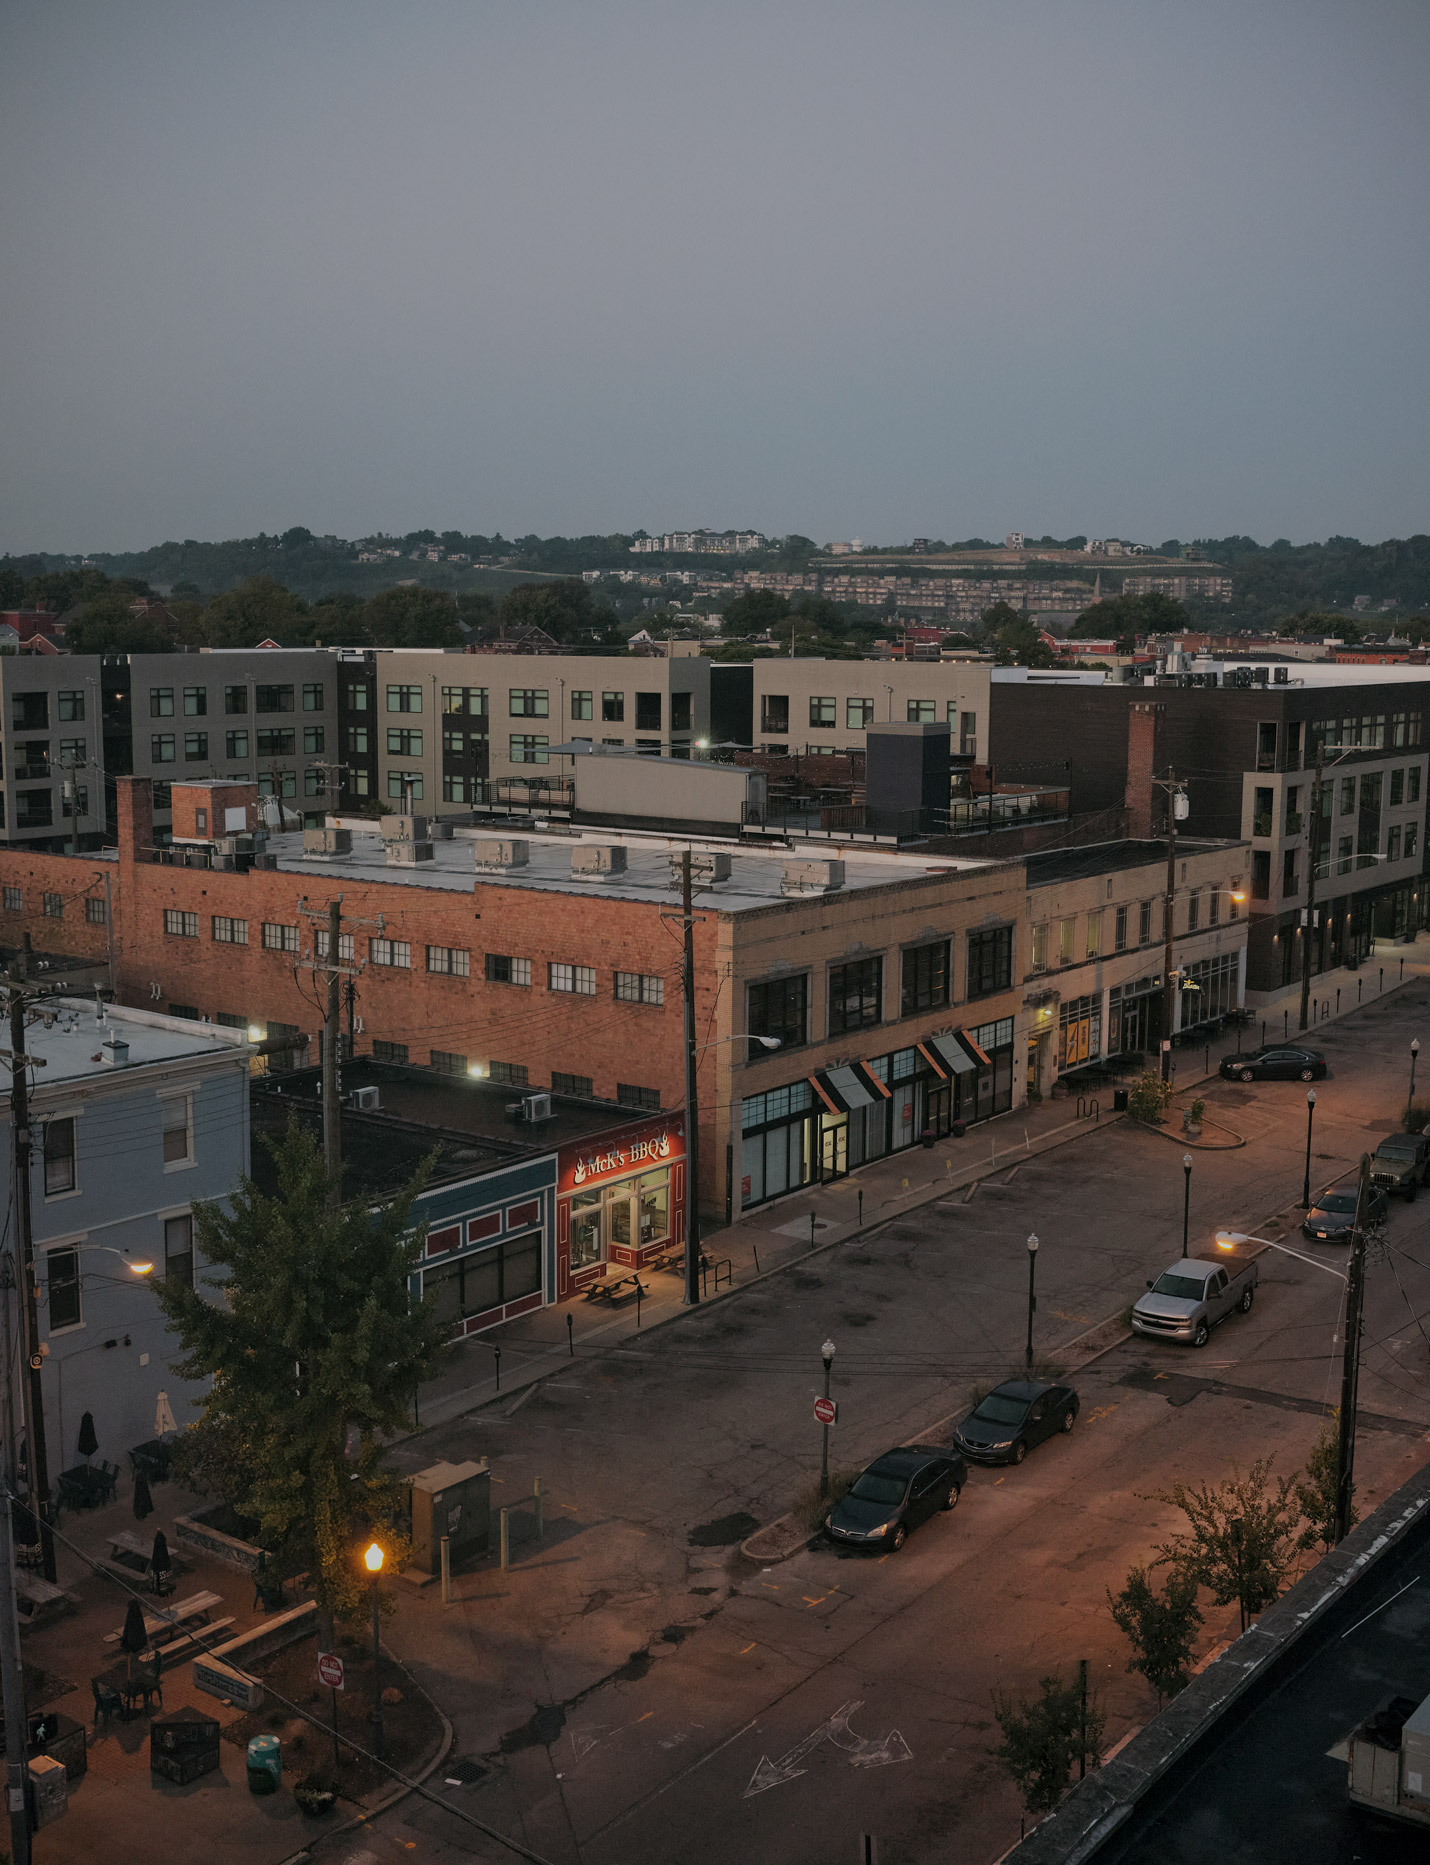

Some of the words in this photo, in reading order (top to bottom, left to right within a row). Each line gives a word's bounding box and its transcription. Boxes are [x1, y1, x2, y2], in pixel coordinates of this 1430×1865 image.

[587, 1149, 625, 1176] McK's
[629, 1138, 659, 1163] BBQ
[321, 1658, 329, 1667] DO
[329, 1660, 339, 1670] NOT
[324, 1672, 339, 1683] ENTER
